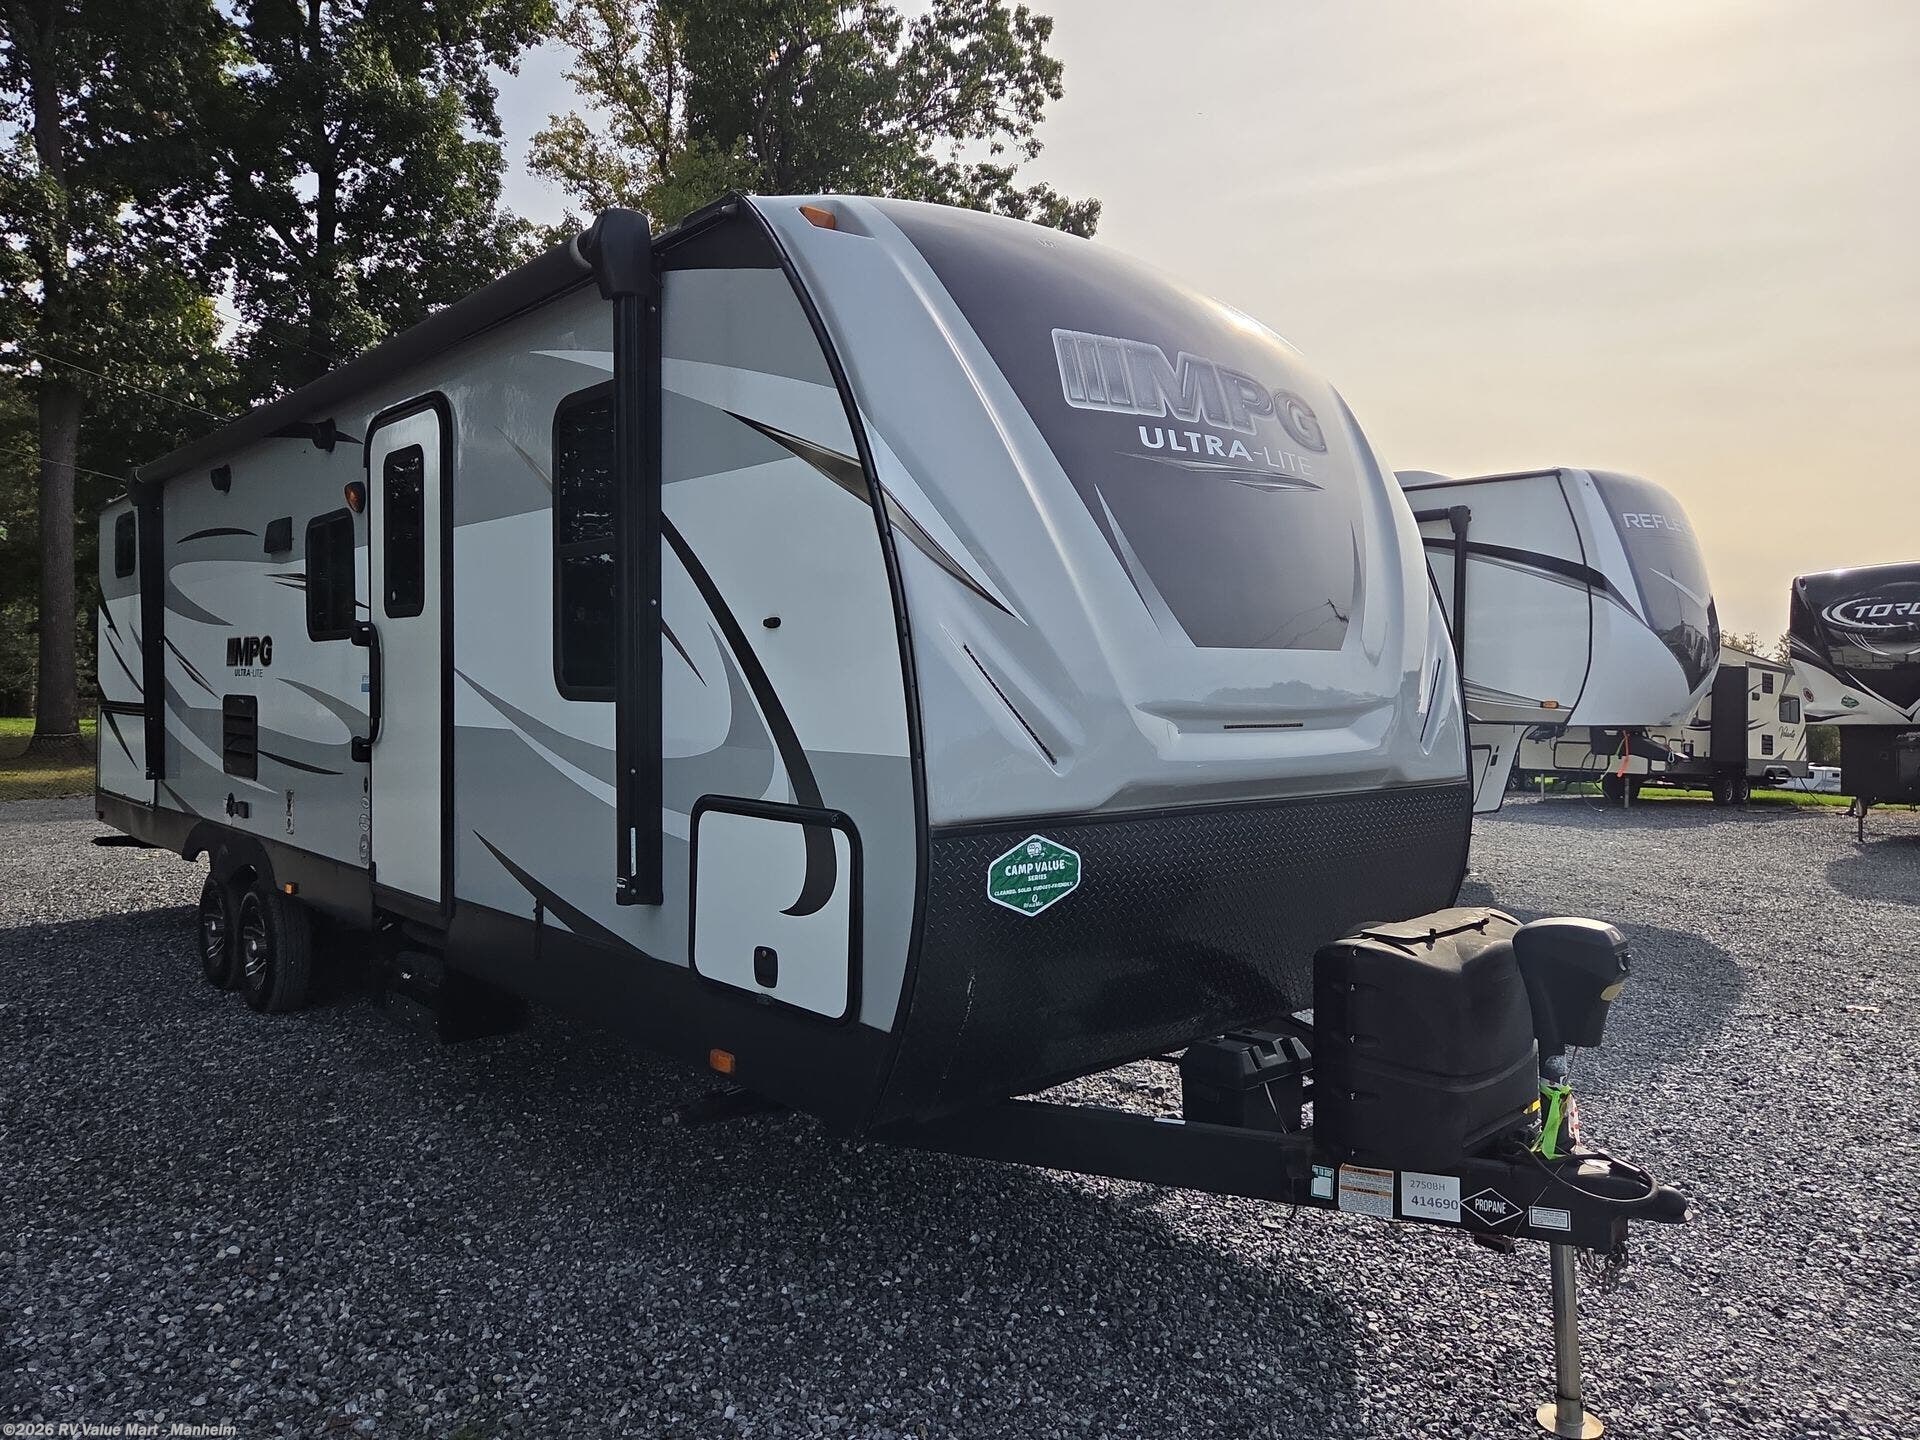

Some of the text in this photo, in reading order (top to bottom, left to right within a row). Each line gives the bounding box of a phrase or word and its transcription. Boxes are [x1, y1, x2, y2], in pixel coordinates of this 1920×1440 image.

[1118, 336, 1328, 452] MPG
[1138, 425, 1313, 476] ULTRA-LITE
[232, 635, 273, 667] MPG
[1005, 860, 1066, 877] CAMP VALUE
[1410, 1179, 1446, 1191] 2750BH
[1411, 1195, 1459, 1210] 414690
[1475, 1198, 1507, 1214] PROPANE
